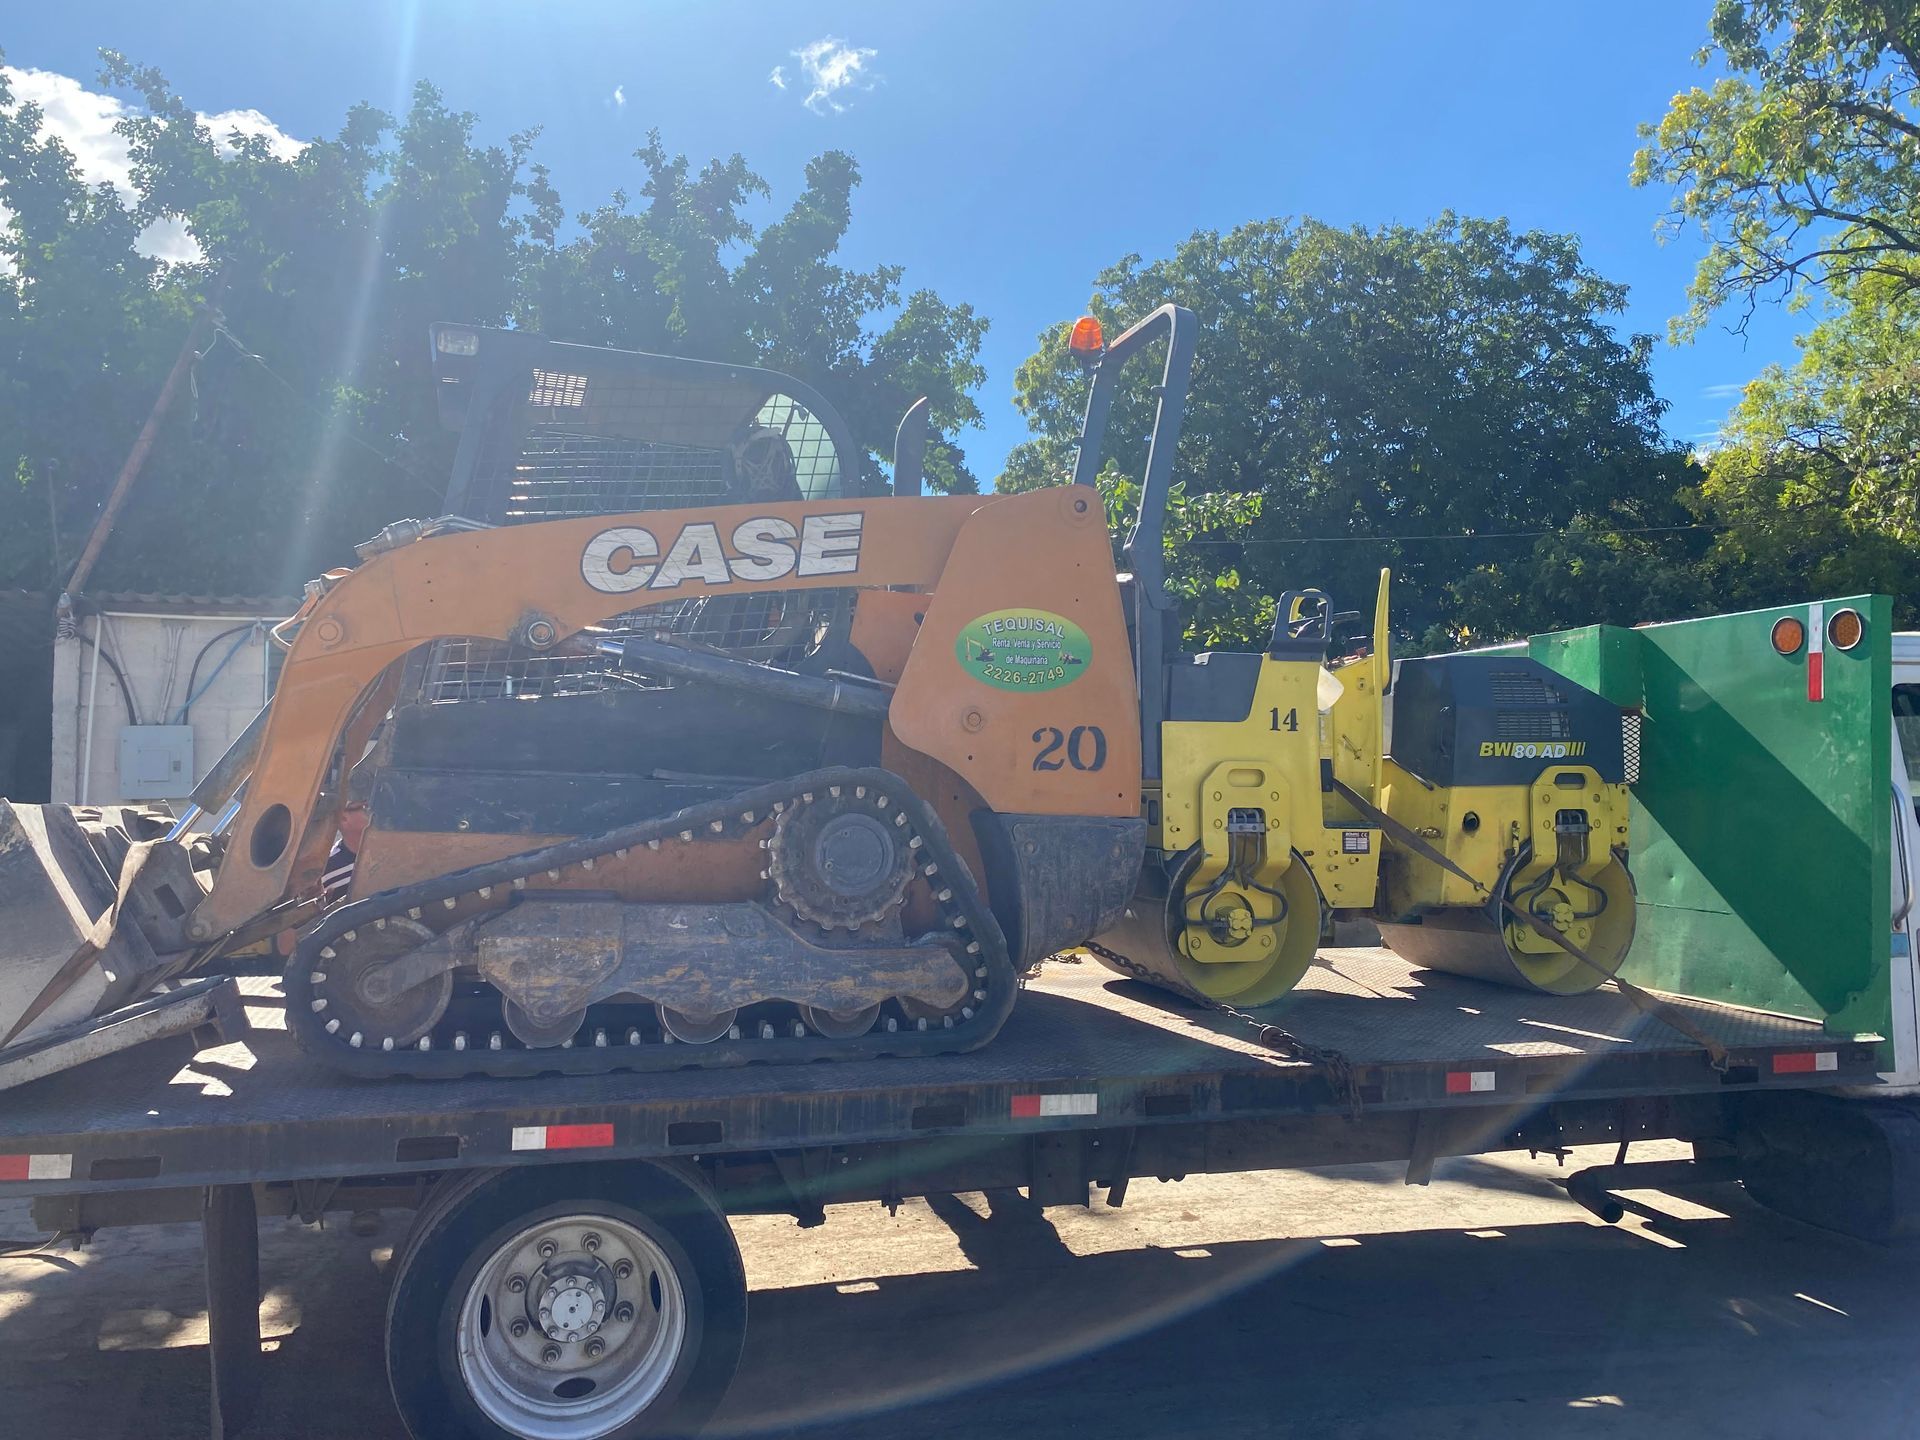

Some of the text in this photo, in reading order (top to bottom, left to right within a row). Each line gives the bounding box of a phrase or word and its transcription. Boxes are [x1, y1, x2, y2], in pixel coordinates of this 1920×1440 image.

[580, 511, 865, 594] CASE
[982, 617, 1065, 639] TEQUISAL
[1014, 639, 1031, 648] Venta
[1037, 638, 1062, 649] Servicio
[1005, 655, 1014, 664] de
[983, 664, 1065, 684] 2226-2749
[1269, 707, 1299, 732] 14
[1032, 725, 1107, 771] 20
[1540, 744, 1567, 759] AD
